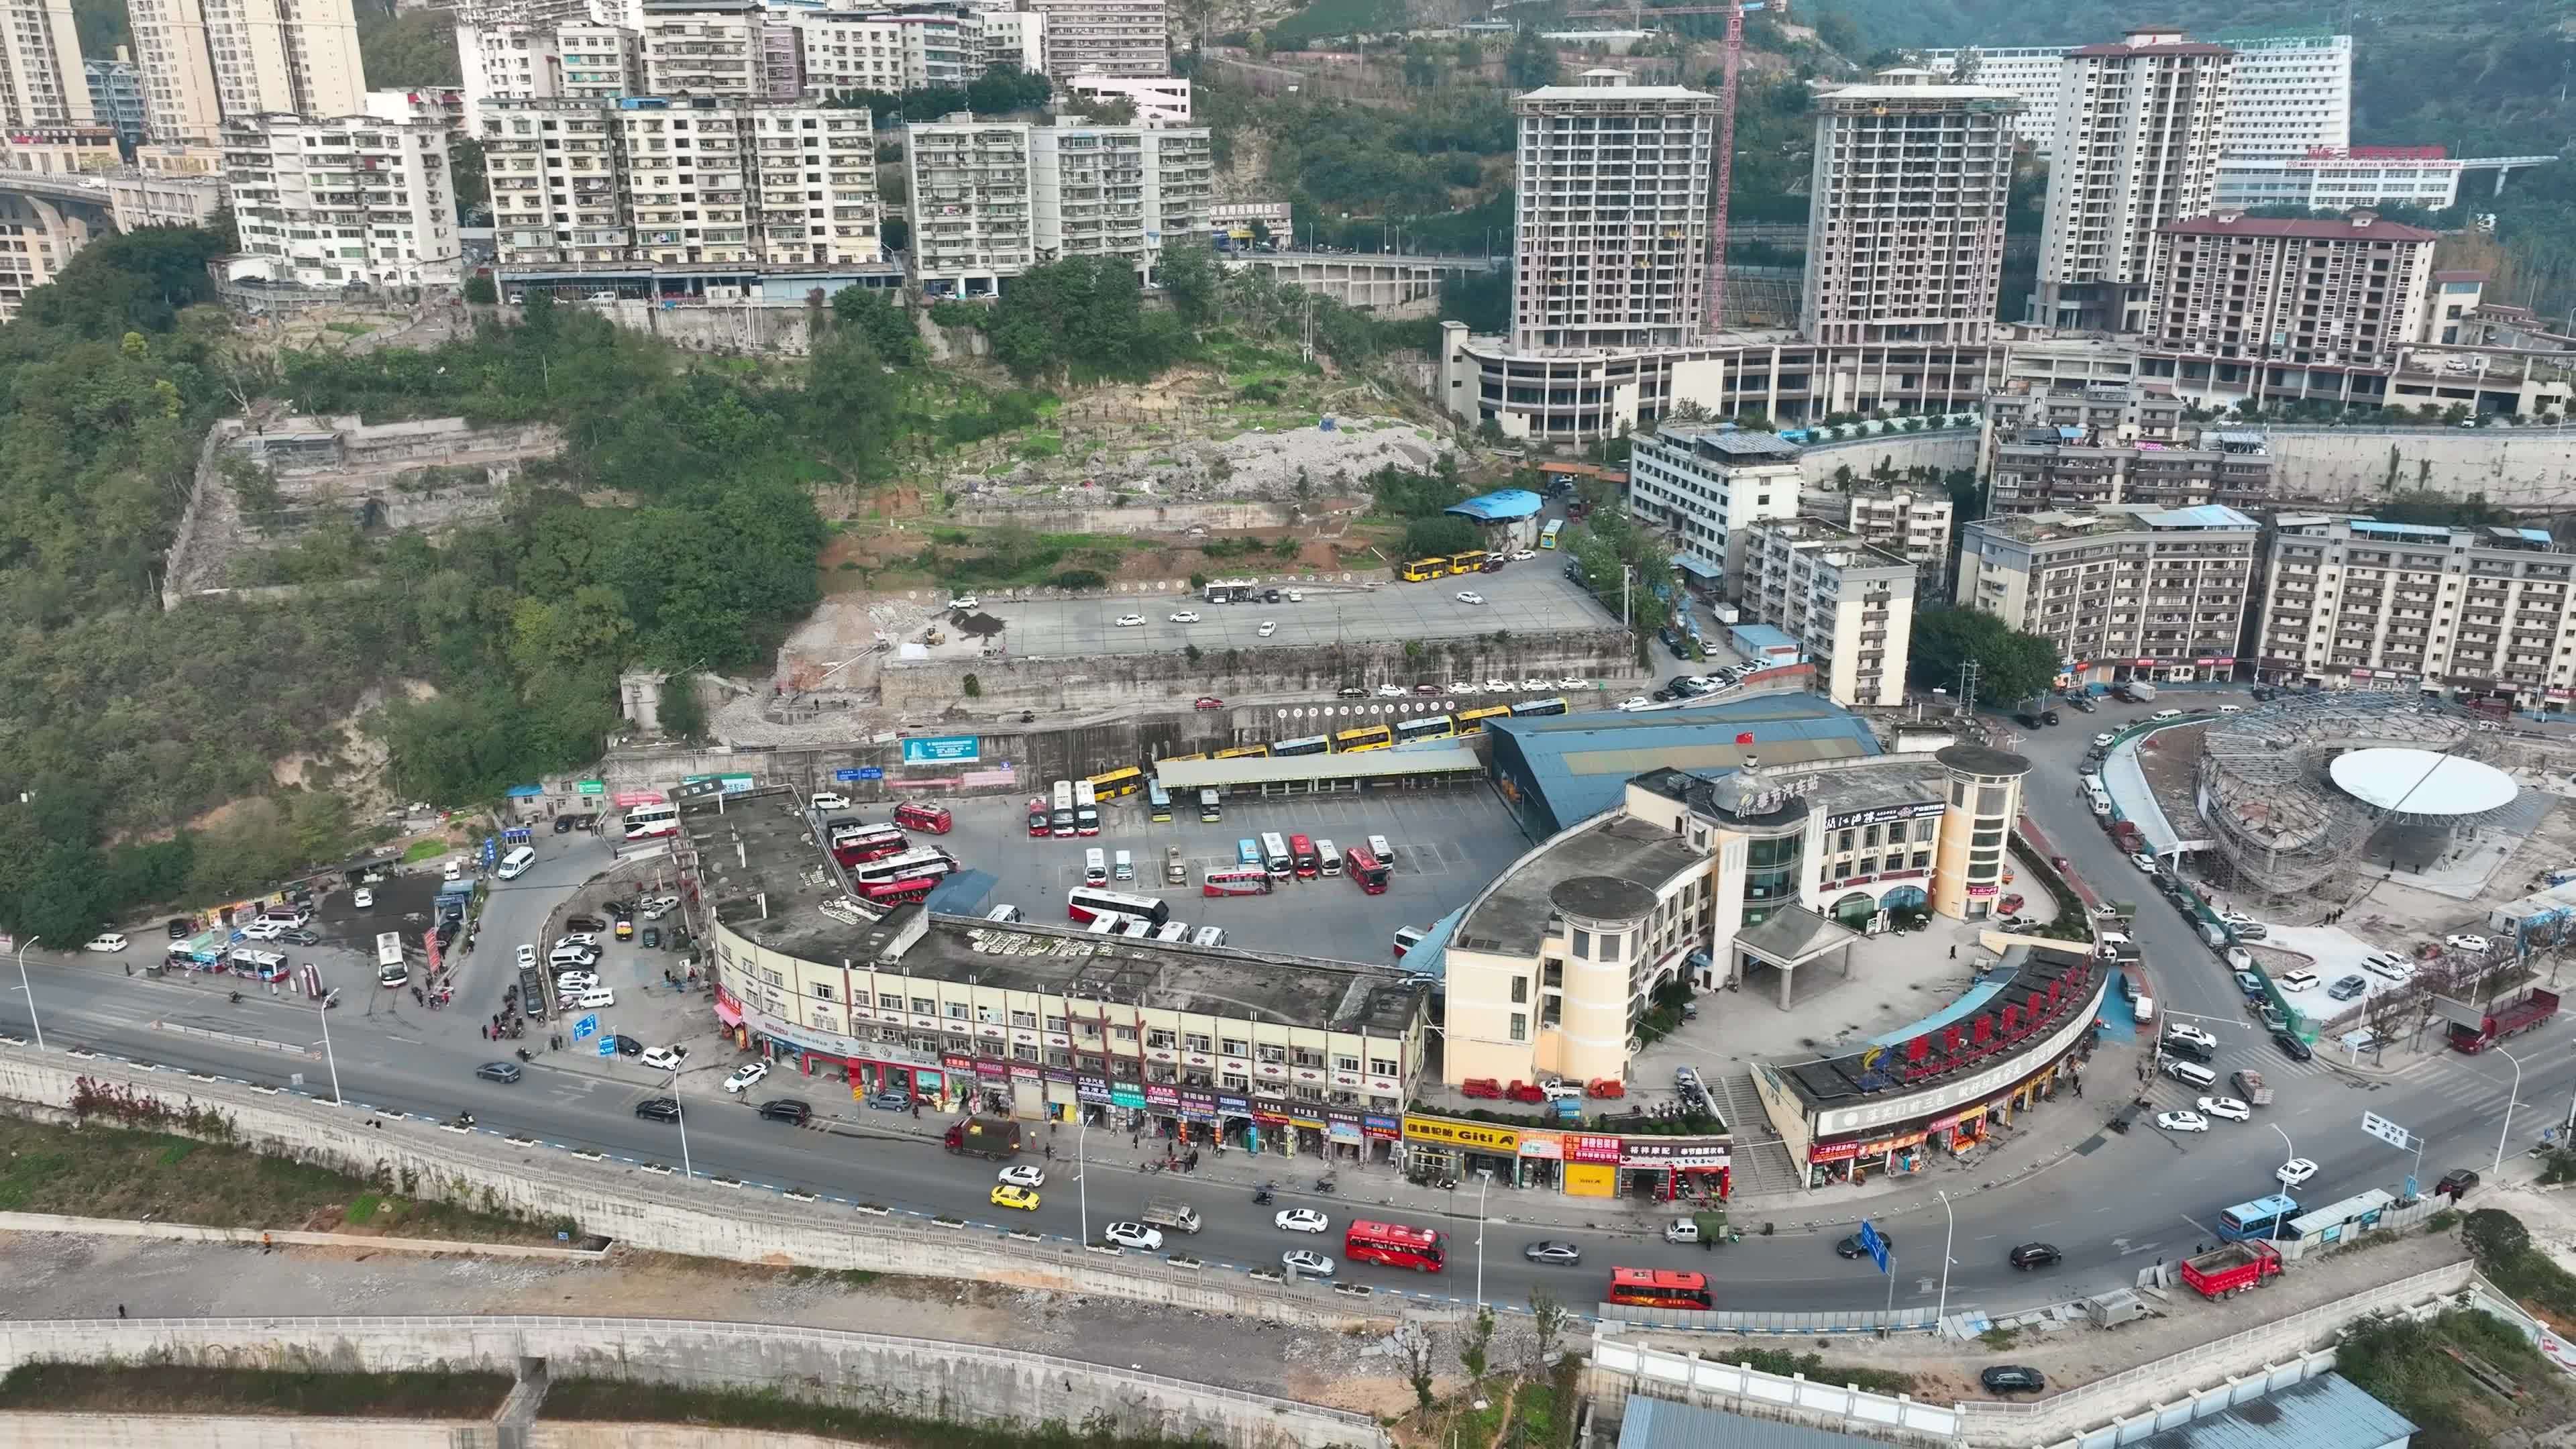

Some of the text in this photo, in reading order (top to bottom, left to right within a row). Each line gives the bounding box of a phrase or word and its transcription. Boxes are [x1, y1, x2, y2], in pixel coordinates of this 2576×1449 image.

[1757, 774, 1819, 808] 奉节汽车站
[1408, 1123, 1453, 1137] 佳通轮胎
[1458, 1131, 1493, 1142] Giti
